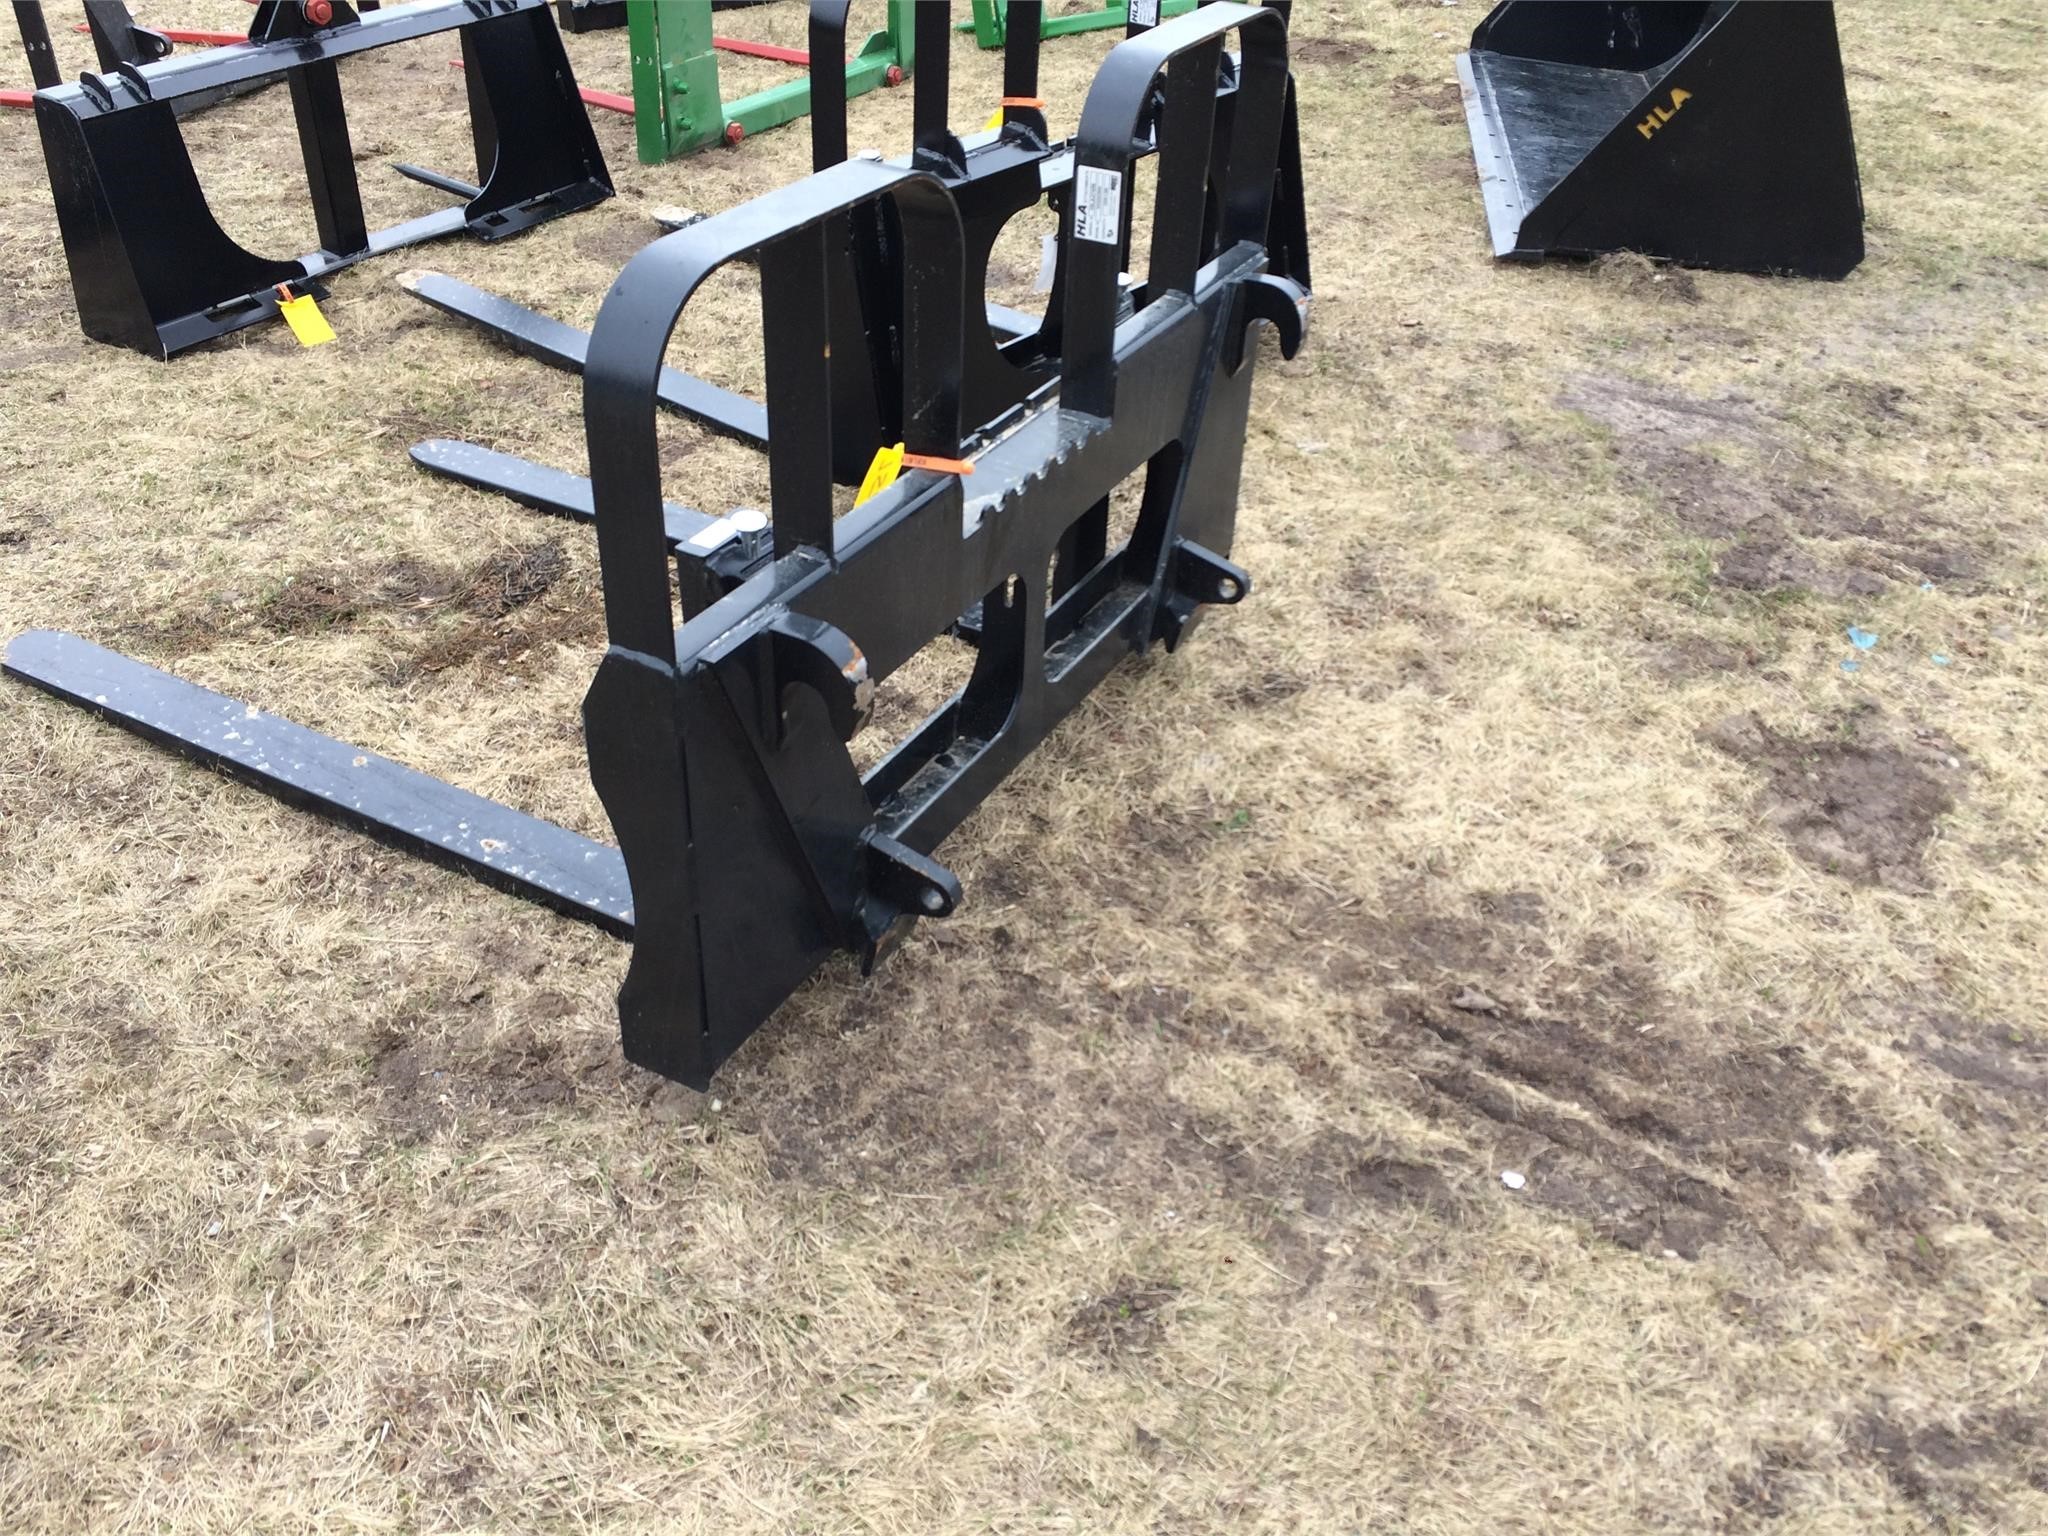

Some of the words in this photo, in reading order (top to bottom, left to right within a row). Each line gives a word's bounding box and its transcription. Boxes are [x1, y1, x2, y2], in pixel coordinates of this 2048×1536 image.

[1131, 0, 1139, 22] HLA
[1636, 88, 1693, 139] HLA
[1077, 205, 1087, 236] HLA
